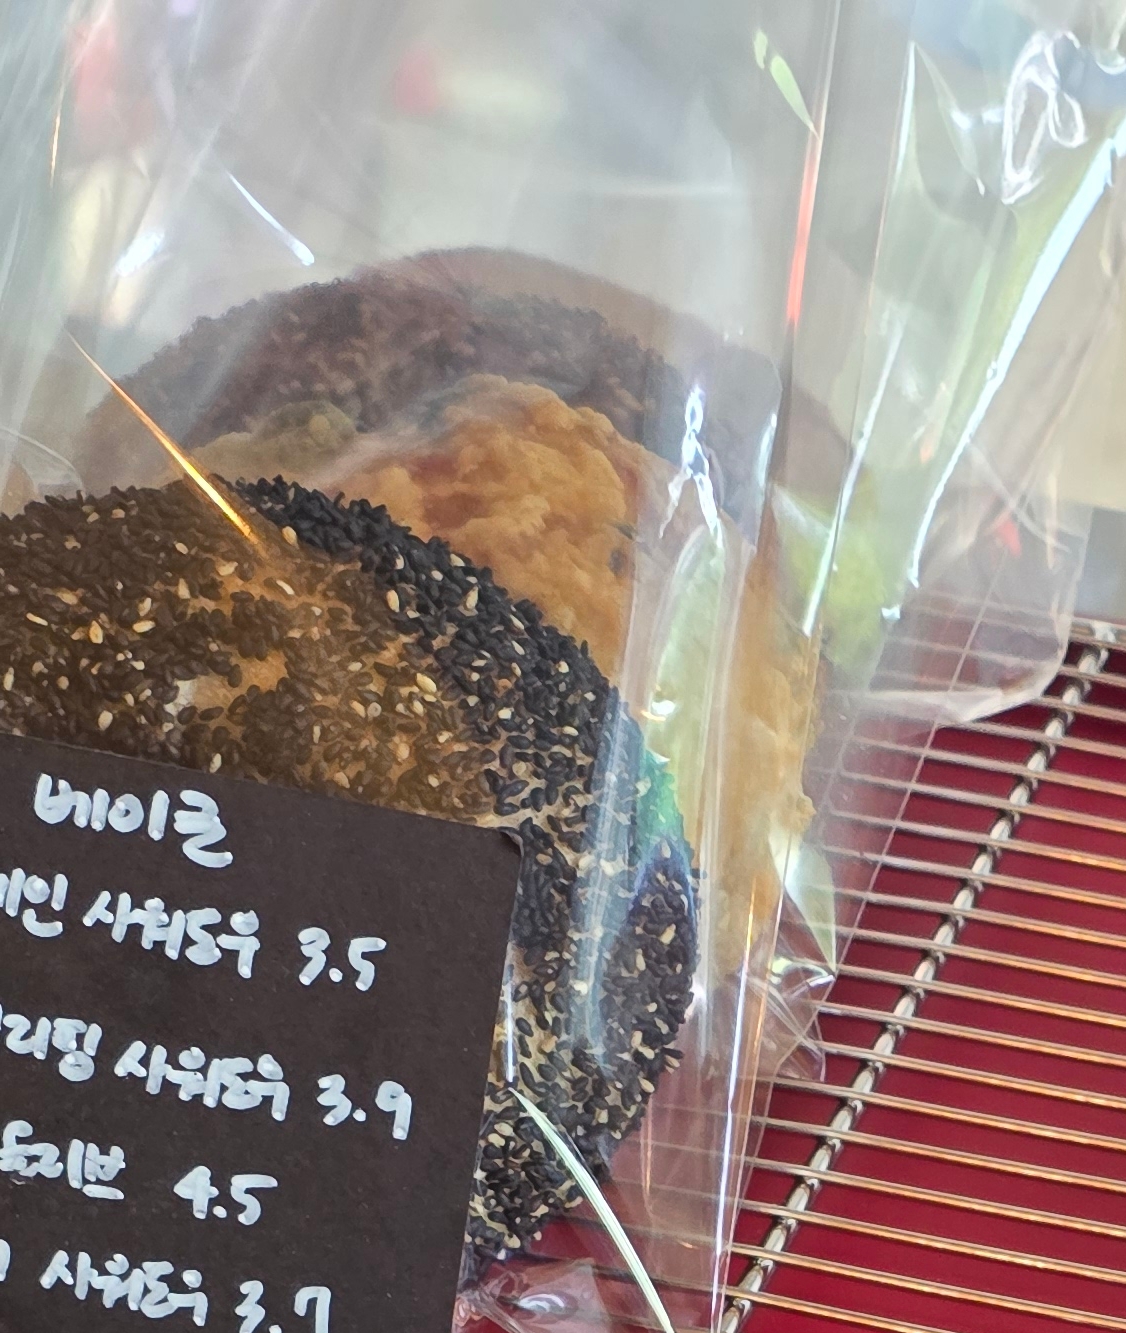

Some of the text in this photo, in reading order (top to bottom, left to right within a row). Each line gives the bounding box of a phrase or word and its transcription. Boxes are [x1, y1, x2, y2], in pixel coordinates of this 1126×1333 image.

[34, 773, 233, 868] 베이글
[298, 926, 387, 992] 3.5
[316, 1073, 413, 1141] 3.9
[173, 1165, 279, 1226] 4.5
